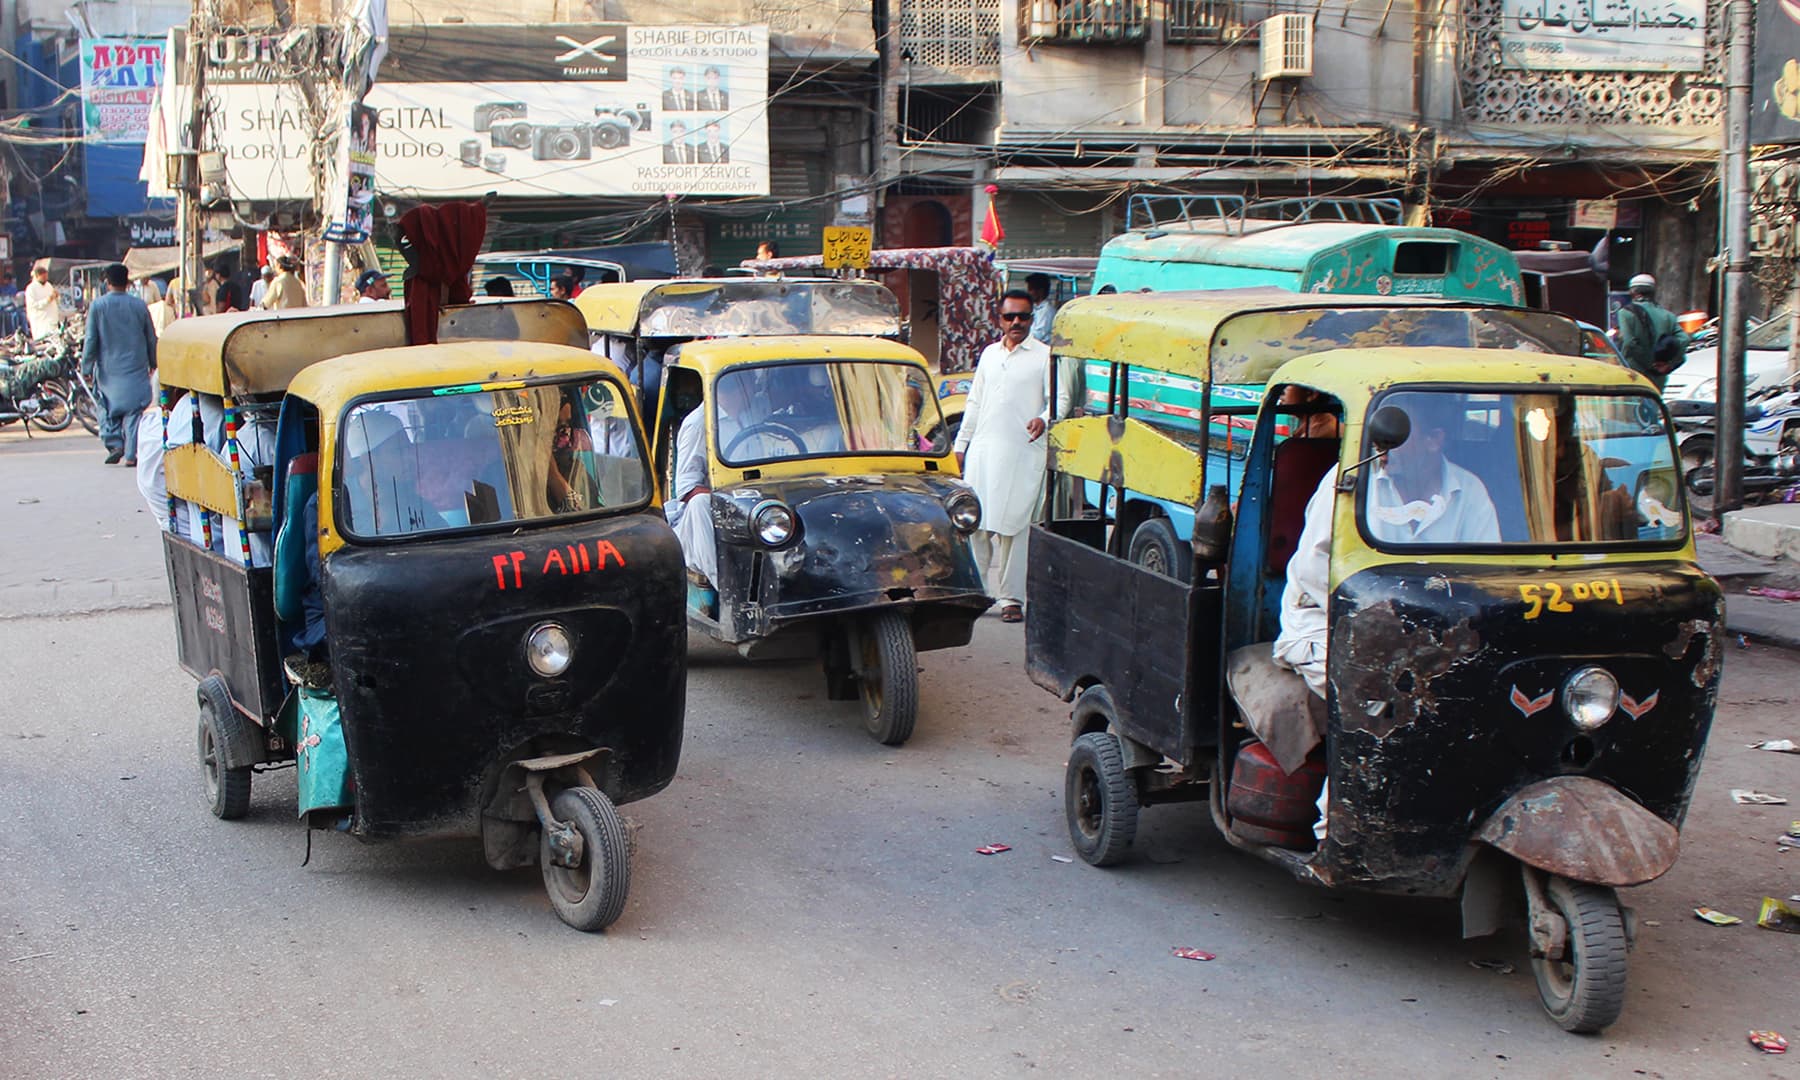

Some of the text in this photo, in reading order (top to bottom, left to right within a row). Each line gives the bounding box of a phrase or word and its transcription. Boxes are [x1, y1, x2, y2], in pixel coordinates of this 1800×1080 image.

[633, 30, 758, 45] SHARIF DIGITAL
[630, 47, 758, 58] COLOR LAB & STUDIO
[562, 66, 609, 76] FUJIFILM
[376, 106, 453, 129] GITAL
[637, 166, 752, 179] PASSPORT SERVICE
[631, 181, 758, 192] OUTDOOR PHOTOGRAPHY
[720, 223, 811, 238] FUJIFILM
